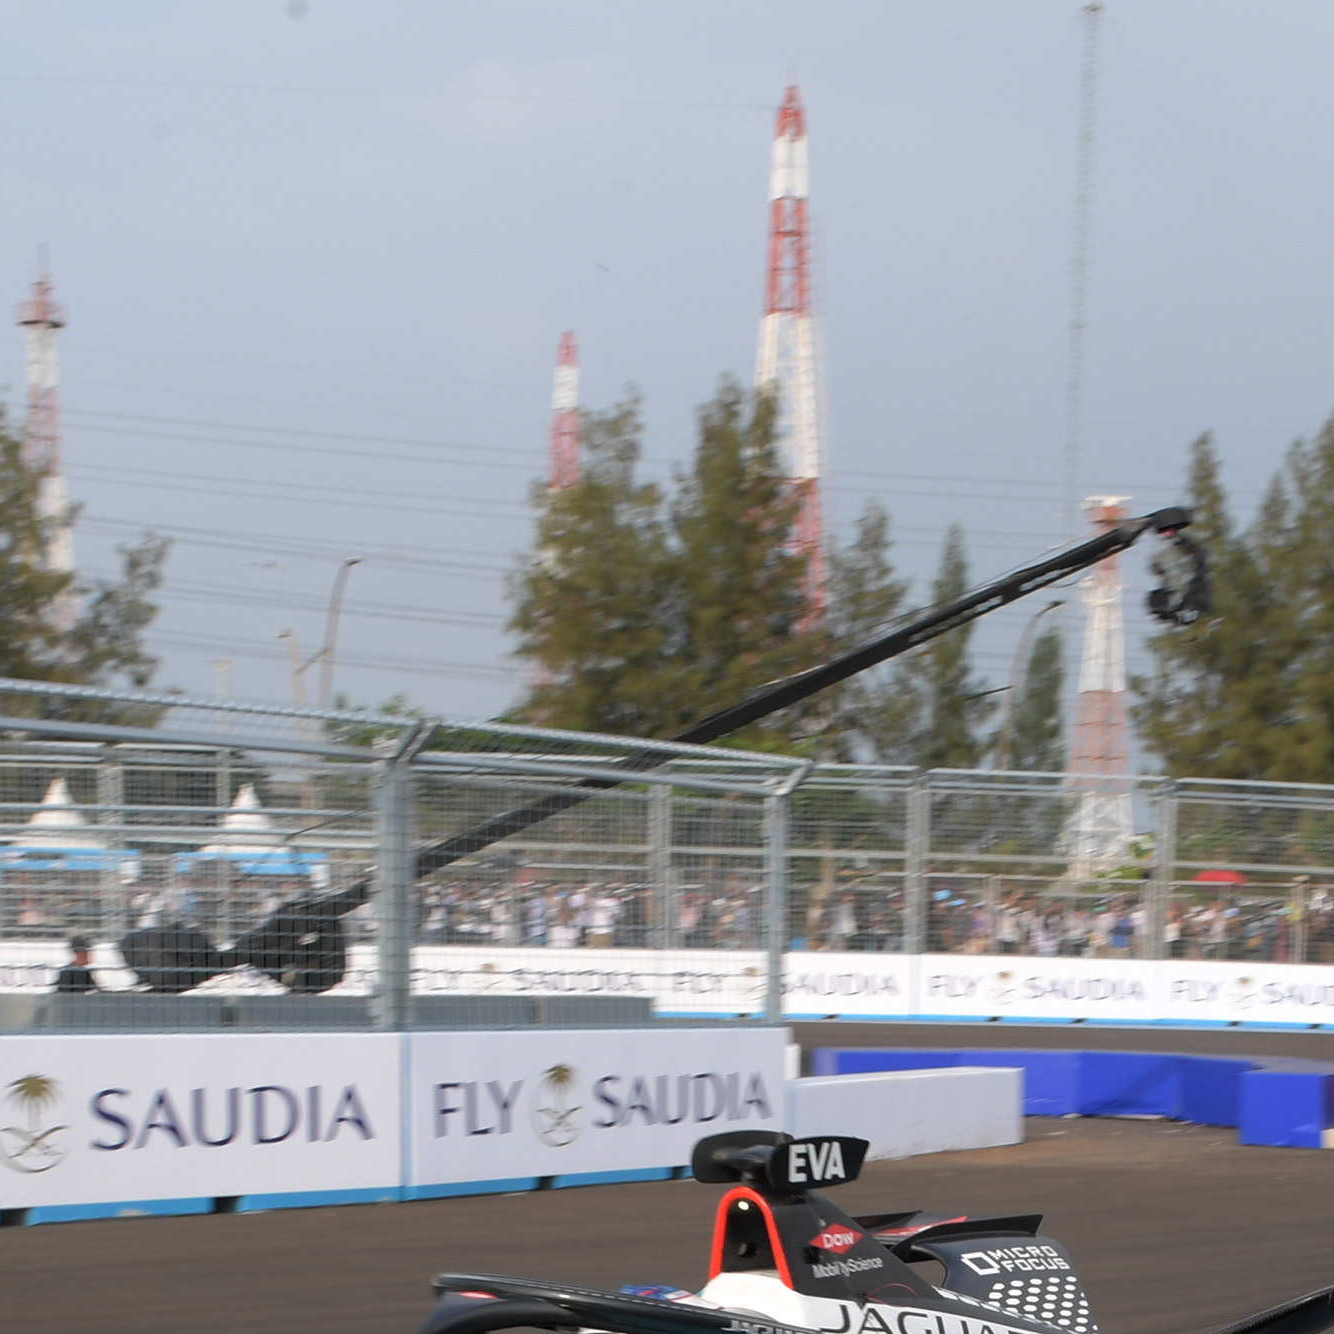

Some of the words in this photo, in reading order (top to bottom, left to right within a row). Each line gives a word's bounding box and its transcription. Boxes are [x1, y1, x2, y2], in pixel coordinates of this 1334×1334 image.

[927, 974, 982, 998] FLY
[1023, 976, 1148, 1001] SAUDIA
[1172, 979, 1224, 1002] FLY
[89, 1083, 375, 1151] SAUDIA
[433, 1079, 524, 1139] FLY
[592, 1070, 774, 1129] SAUDIA
[788, 1141, 846, 1183] EVA
[987, 1245, 1059, 1261] MICRO
[1000, 1258, 1071, 1273] FOCUS
